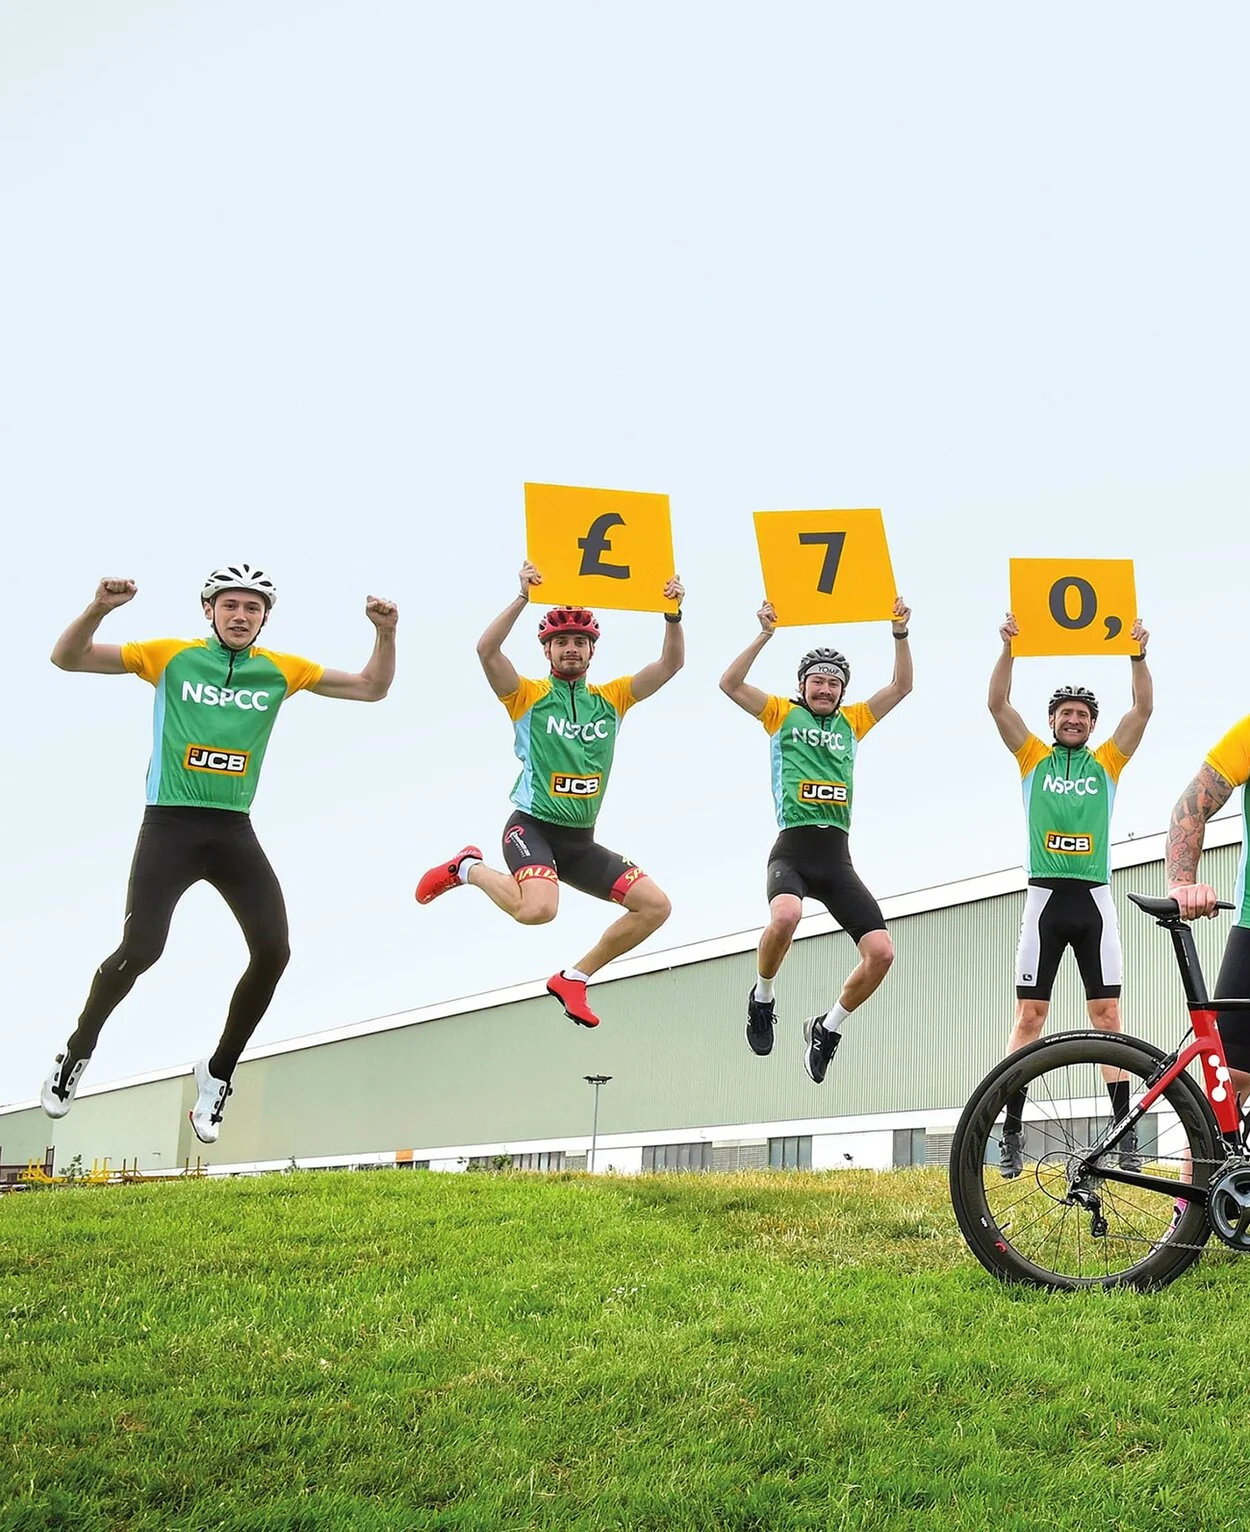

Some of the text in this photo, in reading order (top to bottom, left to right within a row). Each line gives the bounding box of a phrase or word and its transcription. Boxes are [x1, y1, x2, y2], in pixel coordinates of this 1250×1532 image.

[577, 512, 631, 580] £
[798, 531, 847, 595] 7
[1048, 576, 1123, 640] 0,
[182, 680, 270, 711] NSPCC
[791, 727, 846, 751] NSPCC
[189, 751, 246, 771] JCB
[555, 778, 599, 794] JCB
[803, 784, 847, 801] JCB
[1042, 773, 1099, 796] NSPCC
[1048, 836, 1090, 851] JCB
